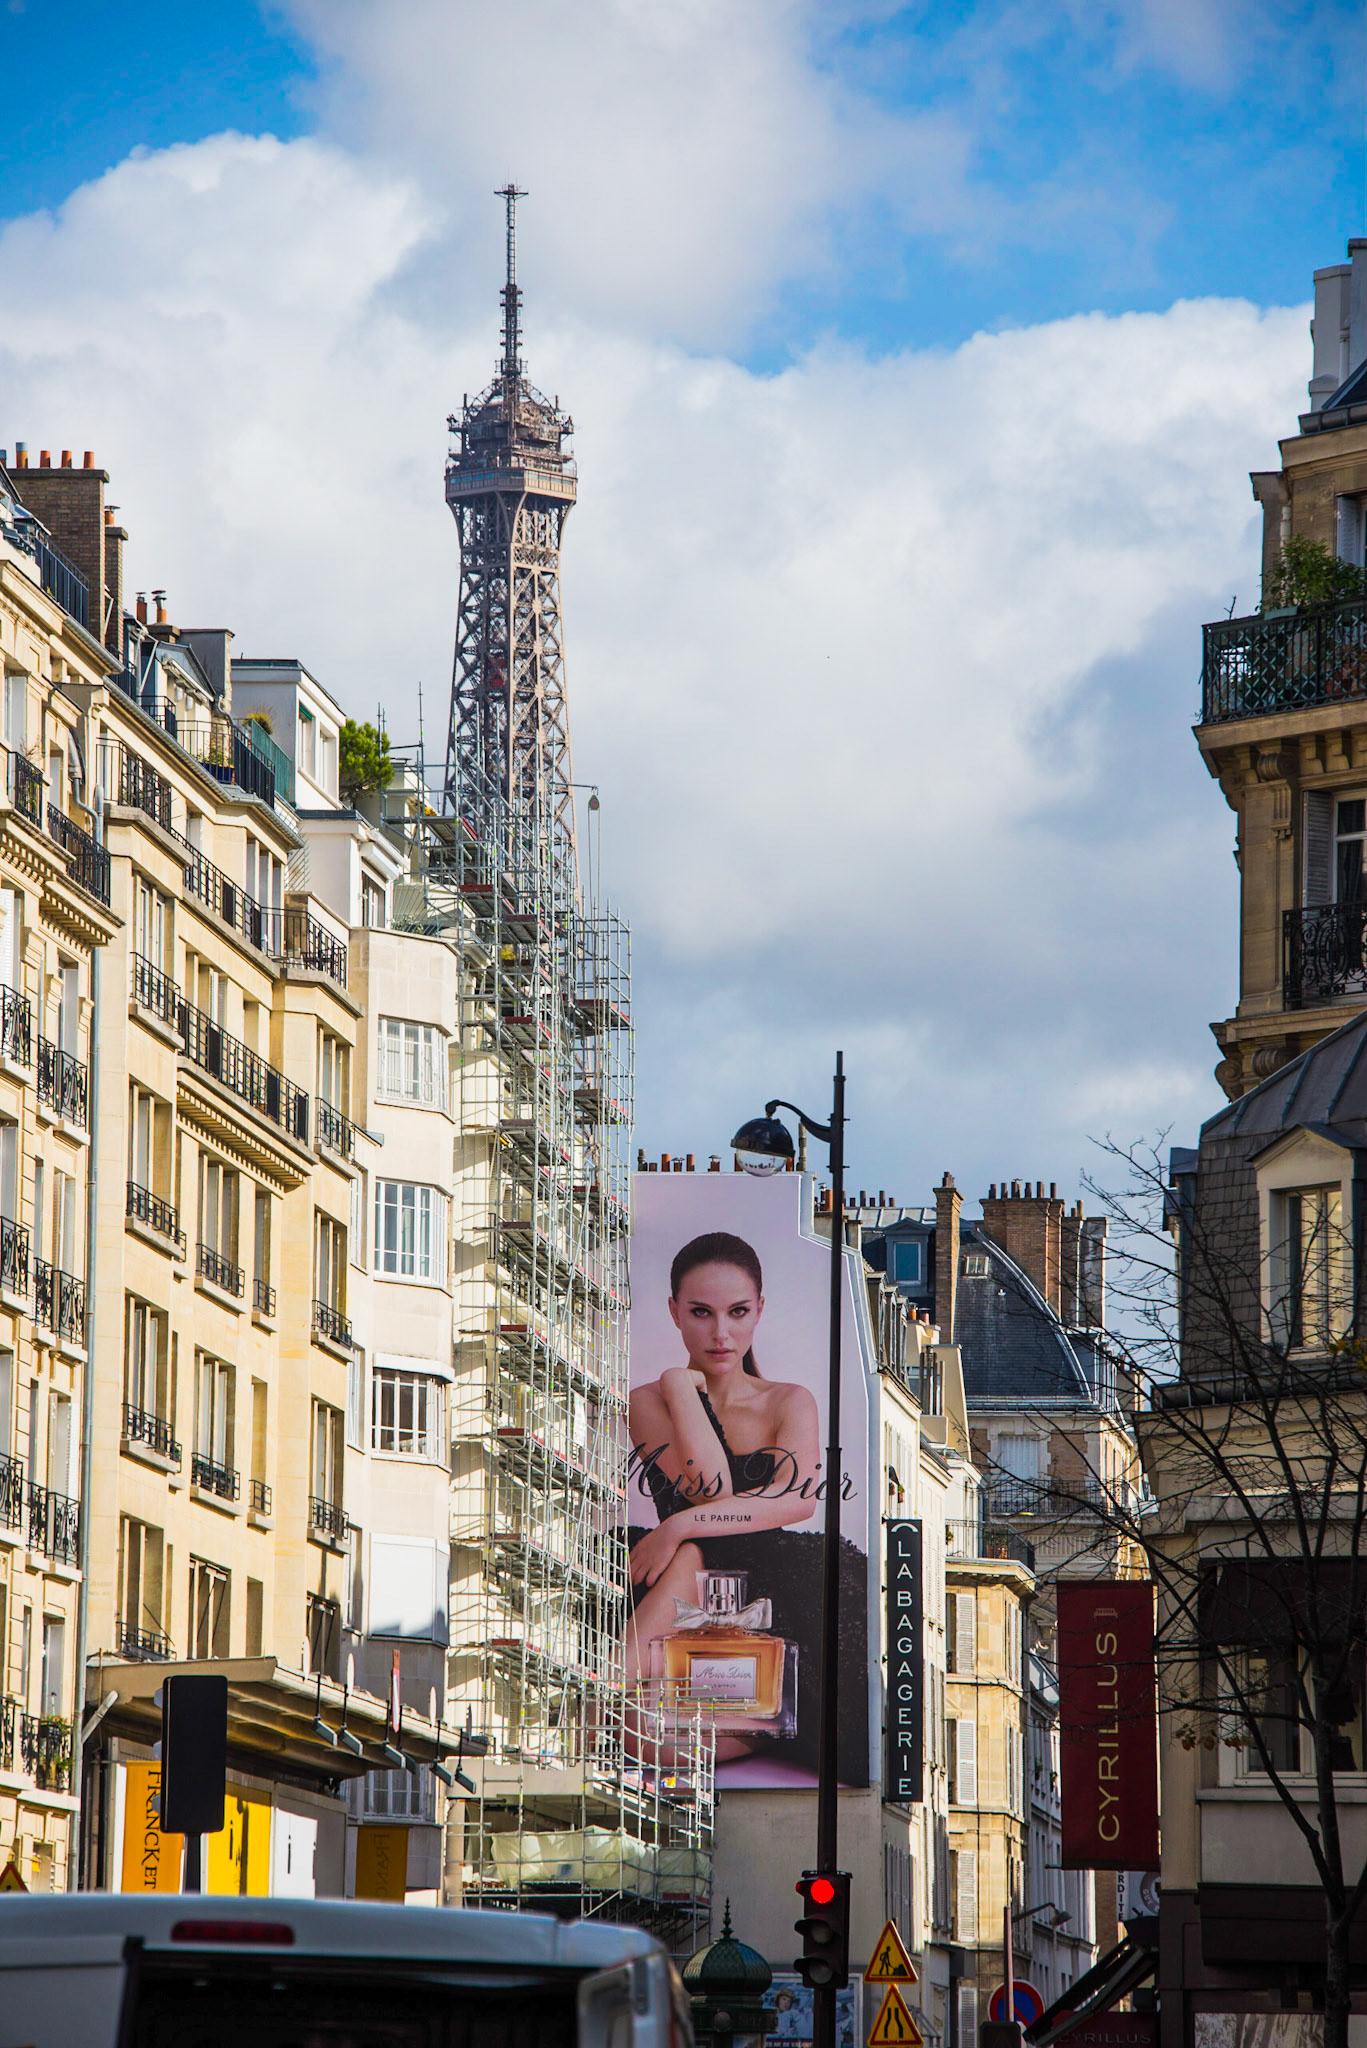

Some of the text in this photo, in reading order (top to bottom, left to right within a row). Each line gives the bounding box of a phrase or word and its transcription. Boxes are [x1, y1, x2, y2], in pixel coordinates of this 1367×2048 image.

[611, 1442, 723, 1498] Miss
[694, 1513, 753, 1523] LE PARFUM
[1094, 1630, 1121, 1843] CYRILLUS
